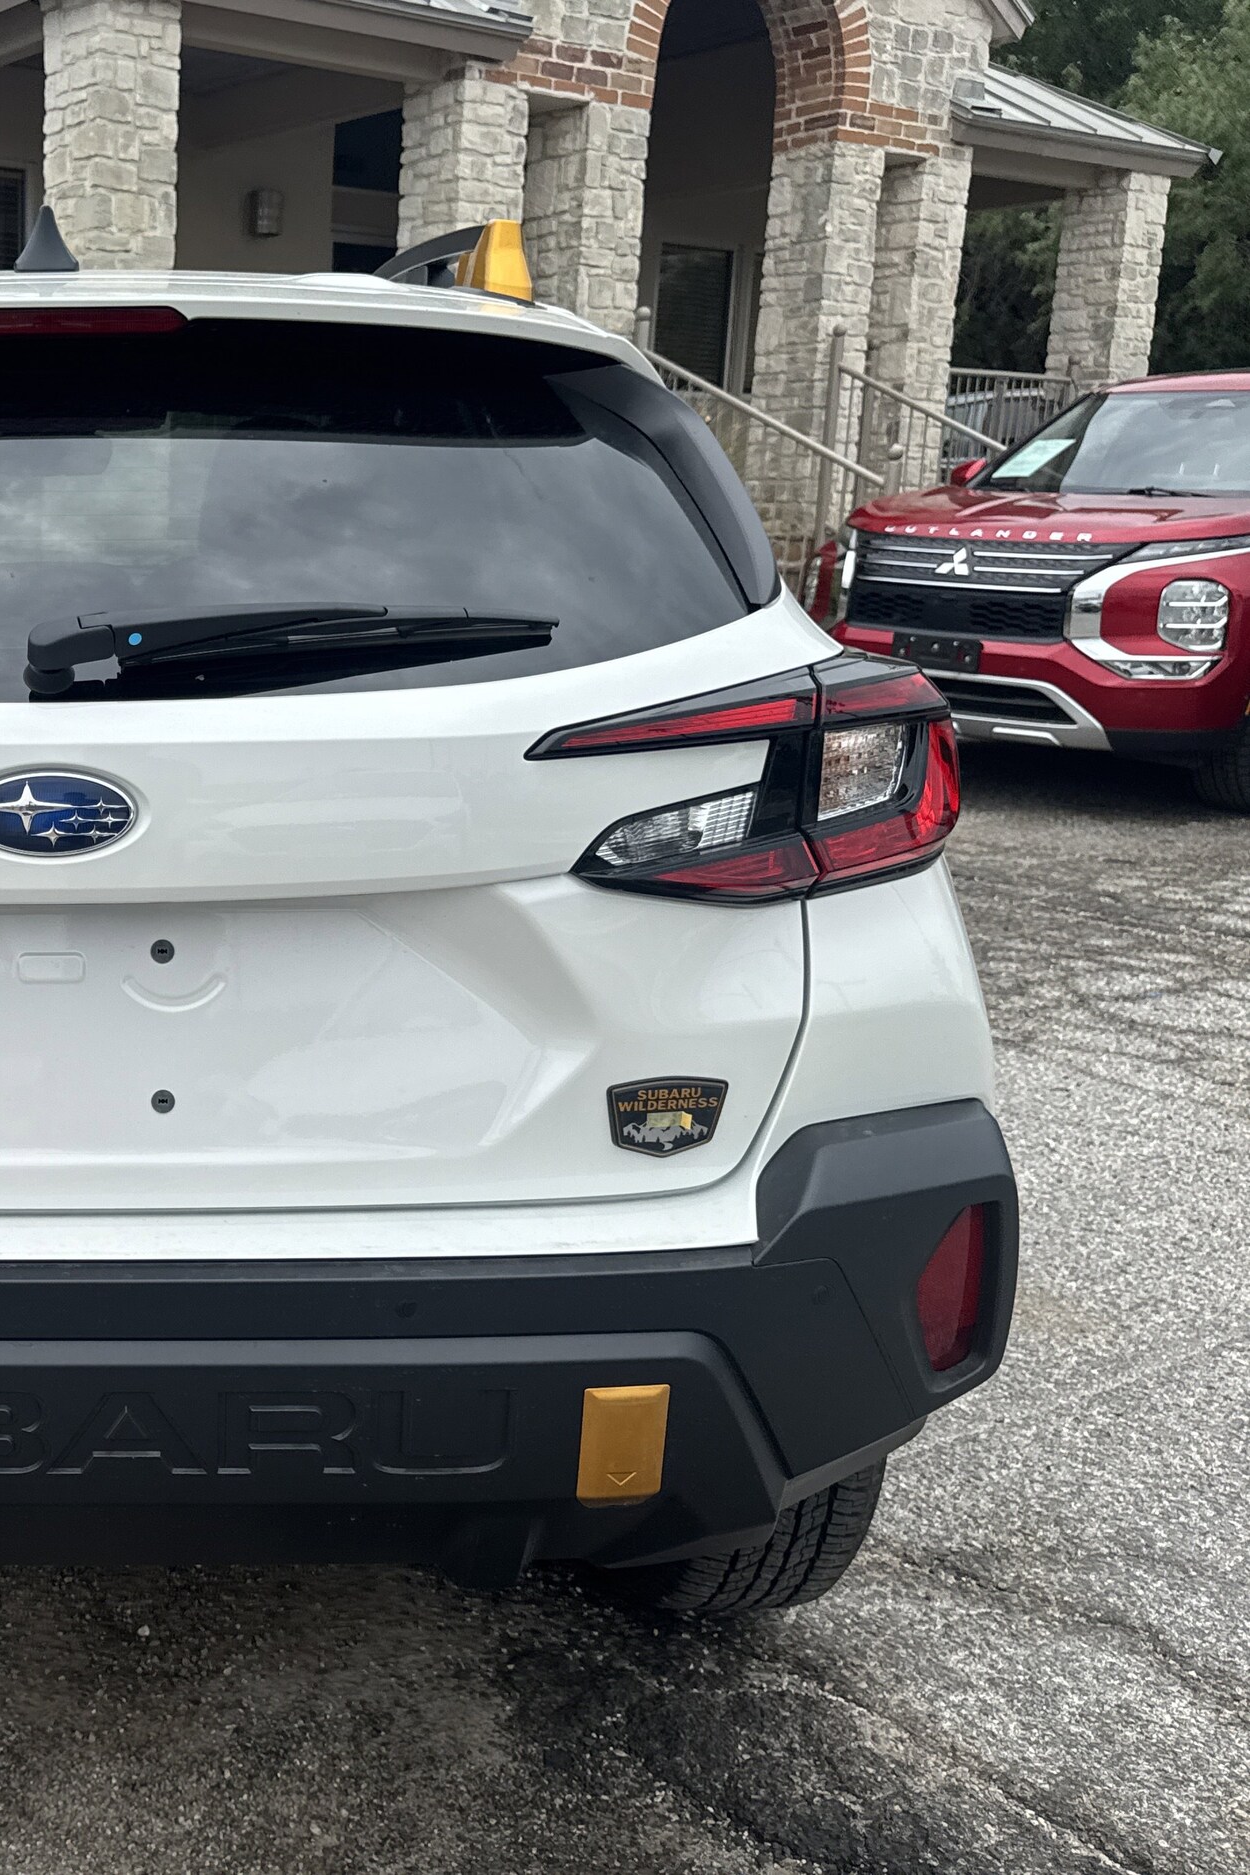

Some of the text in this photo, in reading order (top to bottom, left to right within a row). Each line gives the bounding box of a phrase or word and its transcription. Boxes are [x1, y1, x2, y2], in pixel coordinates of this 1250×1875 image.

[884, 525, 1093, 542] OUTLANDER
[637, 1087, 702, 1101] SUBARU
[617, 1096, 719, 1112] WILDERNESS
